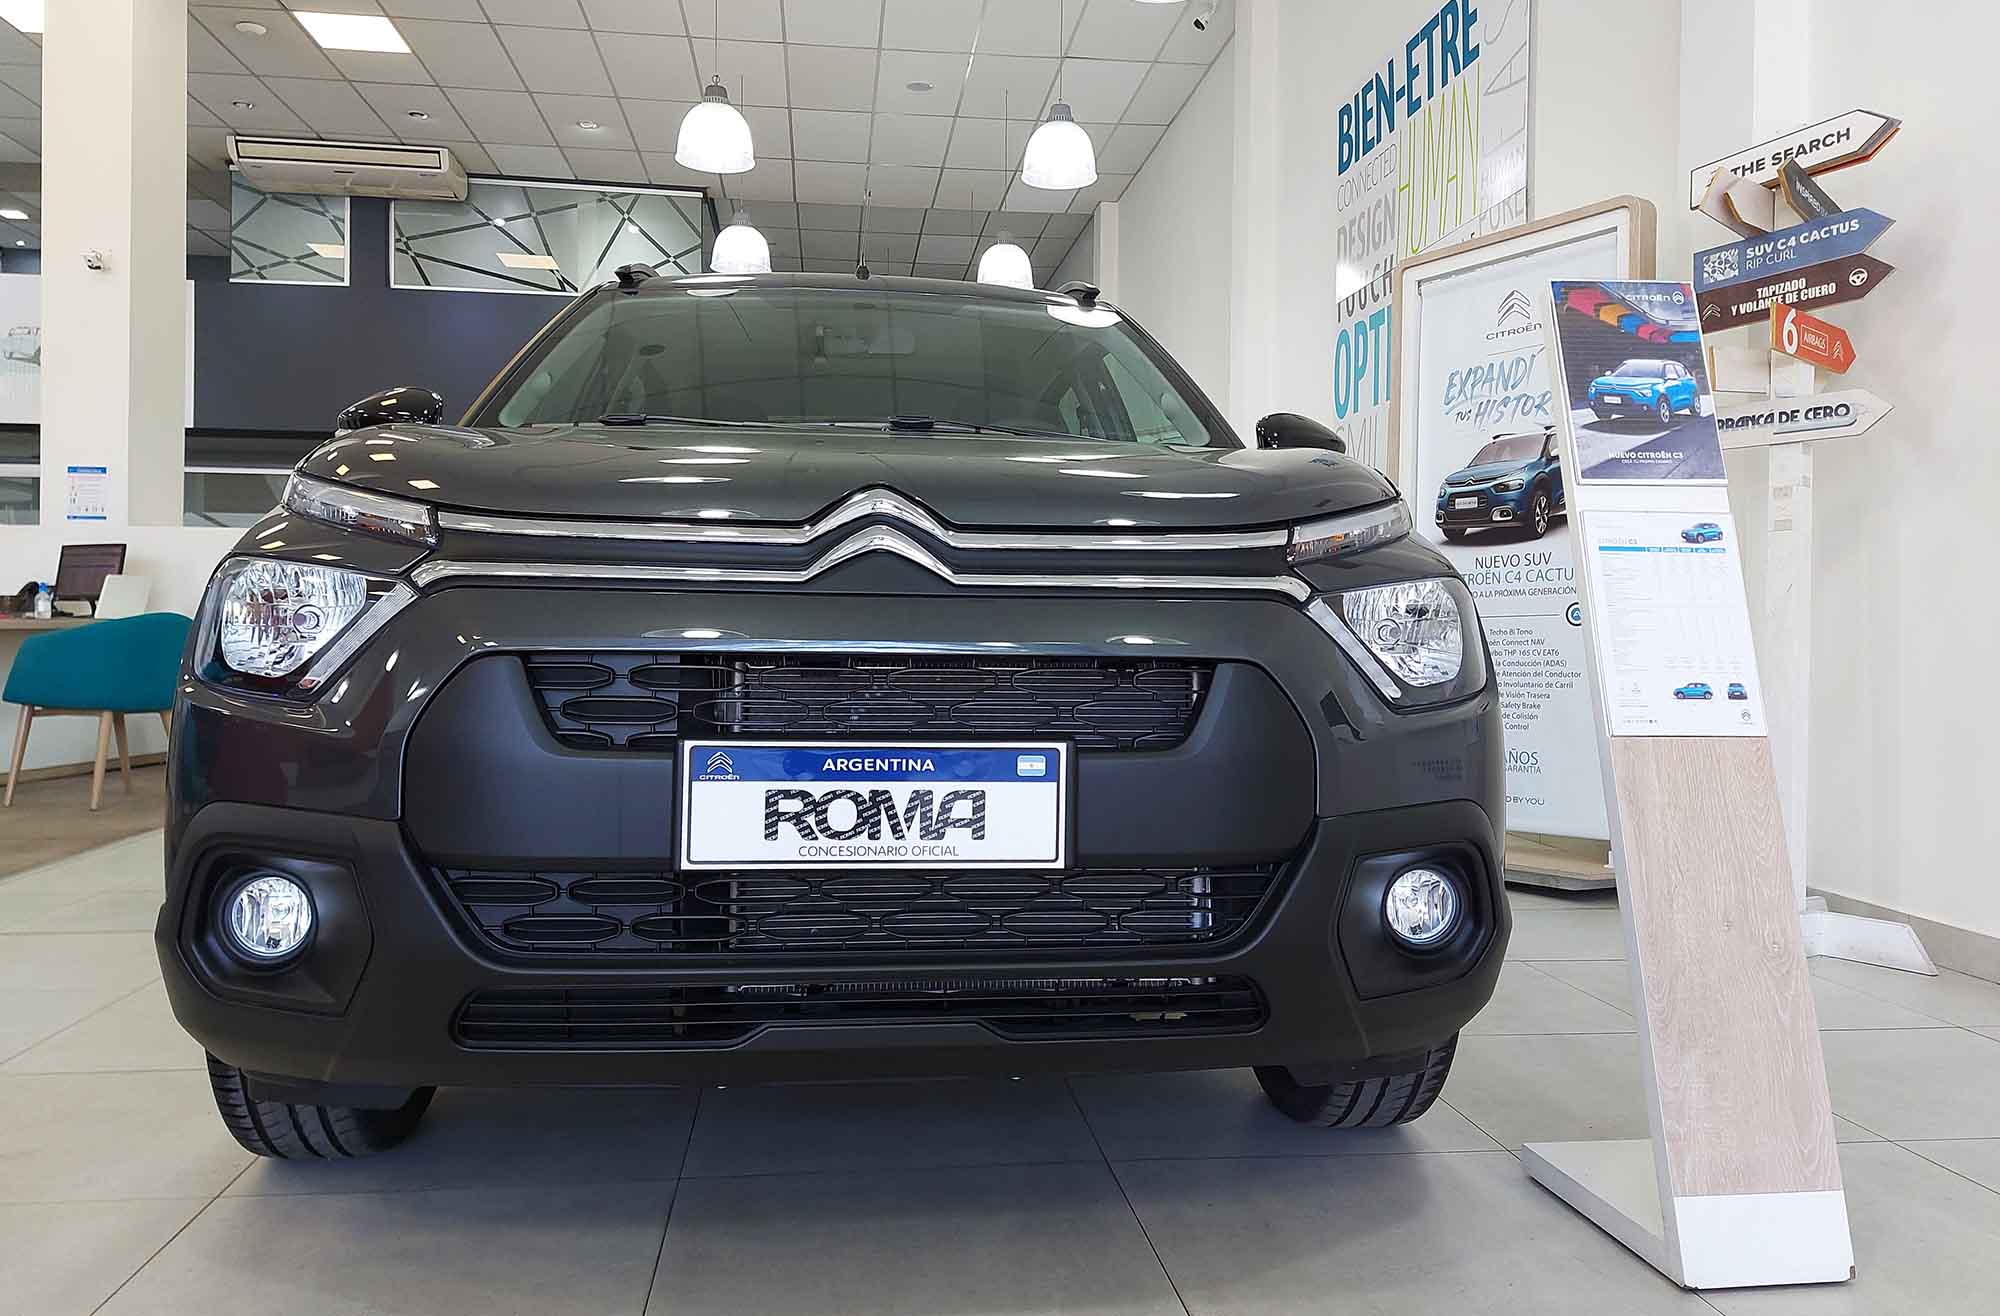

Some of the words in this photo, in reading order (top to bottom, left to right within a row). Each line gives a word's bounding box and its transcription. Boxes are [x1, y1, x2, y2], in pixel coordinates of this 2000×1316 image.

[1337, 0, 1480, 175] BIEN-ETRE
[1731, 158, 1765, 176] THE
[1771, 127, 1850, 166] SEARCH
[1337, 143, 1397, 213] CONNECTED
[1337, 187, 1396, 265] DESIGN
[1746, 242, 1774, 258] SUV
[1777, 236, 1796, 250] C4
[1800, 219, 1860, 244] CACTUS
[1746, 257, 1763, 270] RIP
[1766, 249, 1797, 265] CURL
[1756, 278, 1806, 299] TAPIZADO
[1731, 304, 1738, 317] Y
[1739, 294, 1784, 315] VOLANTE
[1785, 292, 1799, 305] DE
[1800, 282, 1837, 300] CUERO
[1782, 308, 1799, 354] 6
[1778, 409, 1801, 424] DE
[1804, 403, 1851, 421] CERO
[1475, 553, 1521, 569] NUEVO
[1524, 551, 1552, 567] SUV
[1504, 570, 1522, 584] C4
[1525, 567, 1574, 582] CACTU
[1485, 590, 1494, 598] LA
[1494, 588, 1527, 598] PRÓXIMA
[1528, 586, 1577, 596] GENERACIÓN
[1501, 639, 1530, 647] Connect
[1504, 649, 1517, 657] THP
[1502, 659, 1542, 667] Conducción
[1543, 659, 1568, 668] (ADAS)
[1501, 670, 1531, 678] Atención
[1532, 669, 1544, 678] del
[1544, 670, 1582, 678] Conductor
[1526, 691, 1551, 699] Trasera
[1501, 701, 1521, 709] Safety
[1502, 712, 1511, 720] de
[1511, 712, 1539, 720] Colisión
[1504, 722, 1529, 730] Control
[822, 757, 935, 772] ARGENTINA
[1513, 796, 1524, 804] BY
[1525, 796, 1545, 806] YOU
[764, 789, 986, 841] ROMA
[798, 845, 908, 857] CONCESIONARIO
[911, 845, 959, 857] OFICIAL
